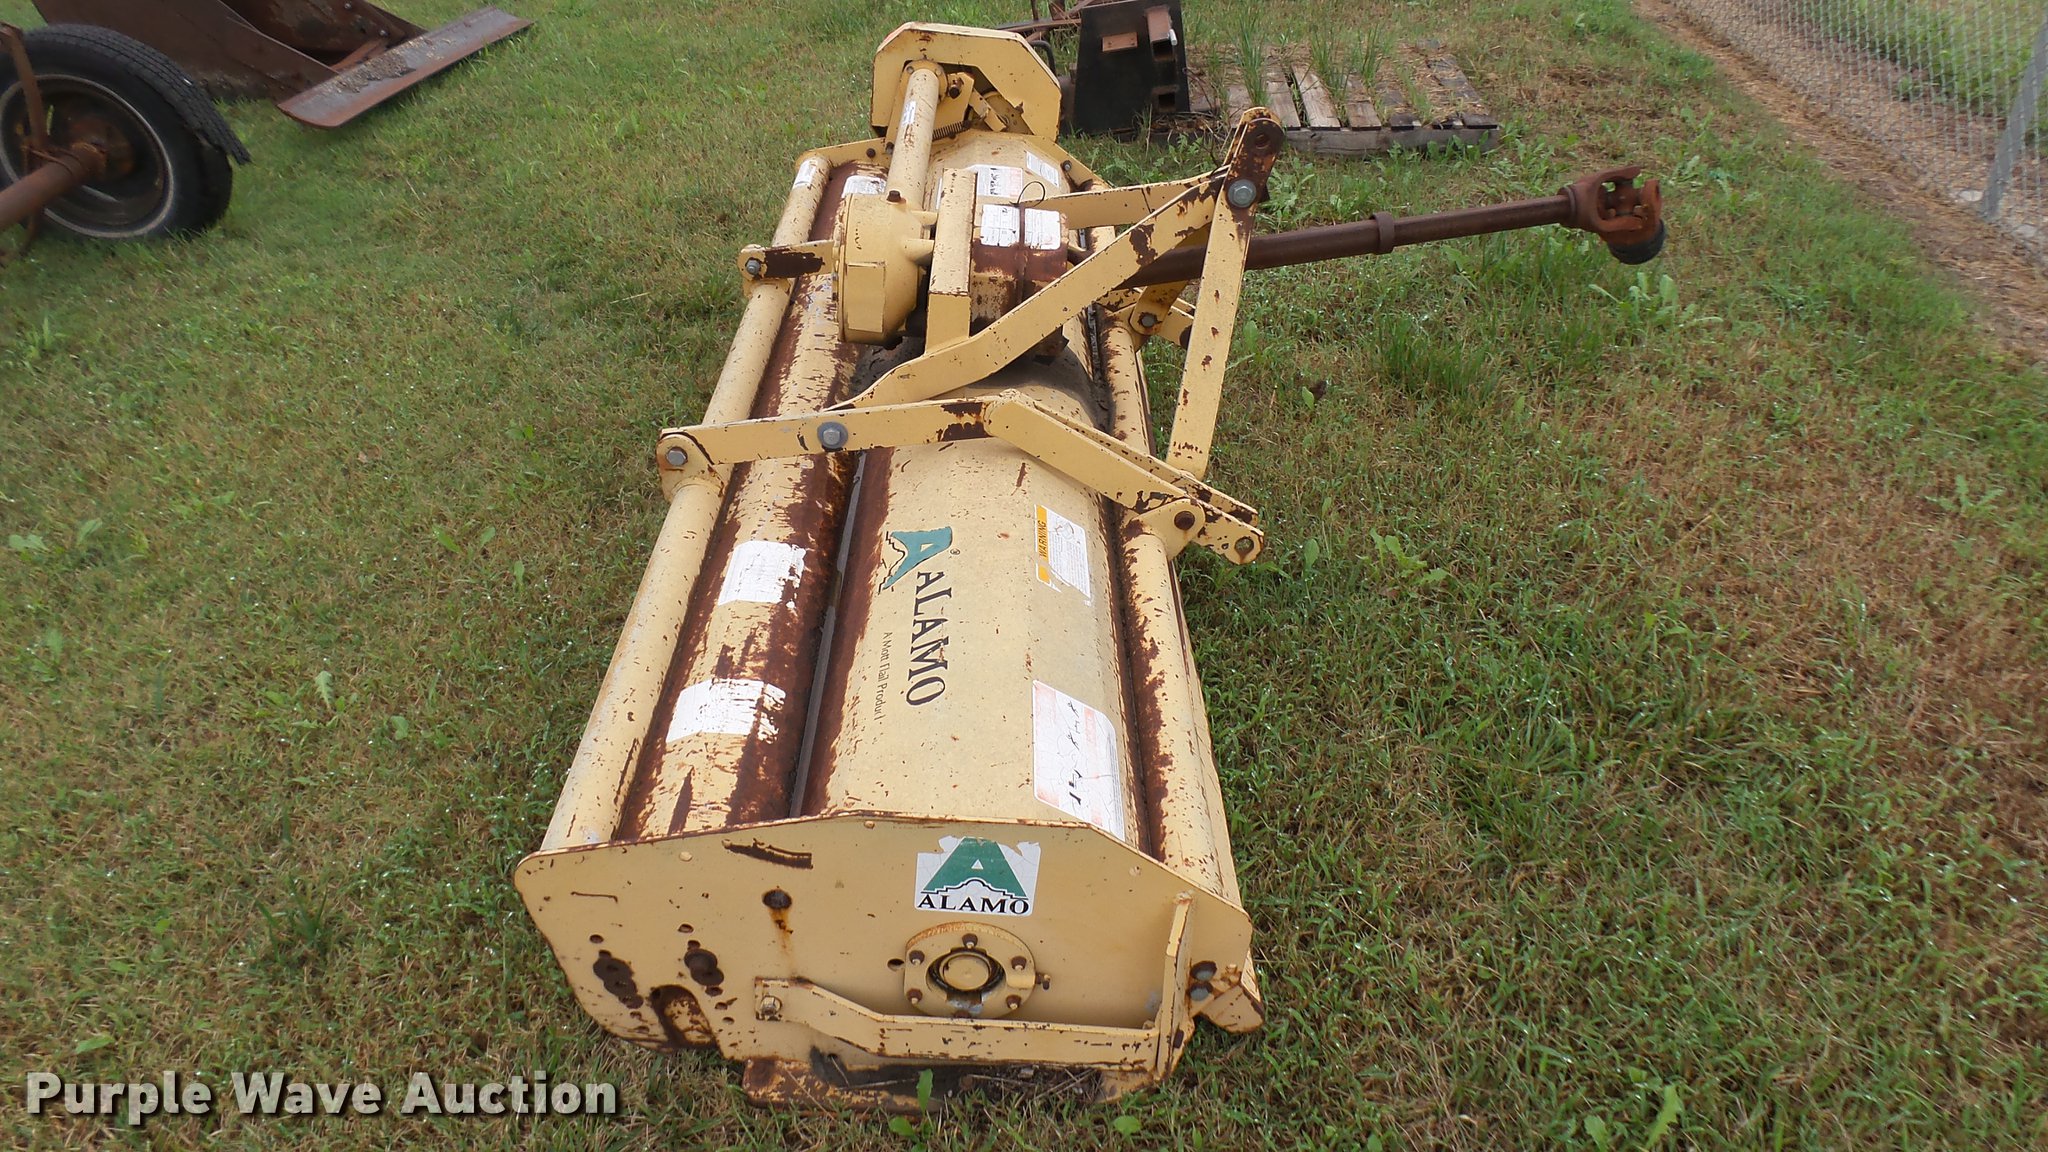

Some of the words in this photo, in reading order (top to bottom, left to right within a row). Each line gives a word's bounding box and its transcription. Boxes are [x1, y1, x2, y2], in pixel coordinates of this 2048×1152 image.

[1038, 520, 1047, 557] WARNING
[883, 632, 893, 640] A
[906, 571, 952, 706] ALAMO
[880, 640, 892, 661] Mott
[917, 894, 1029, 915] ALAMO
